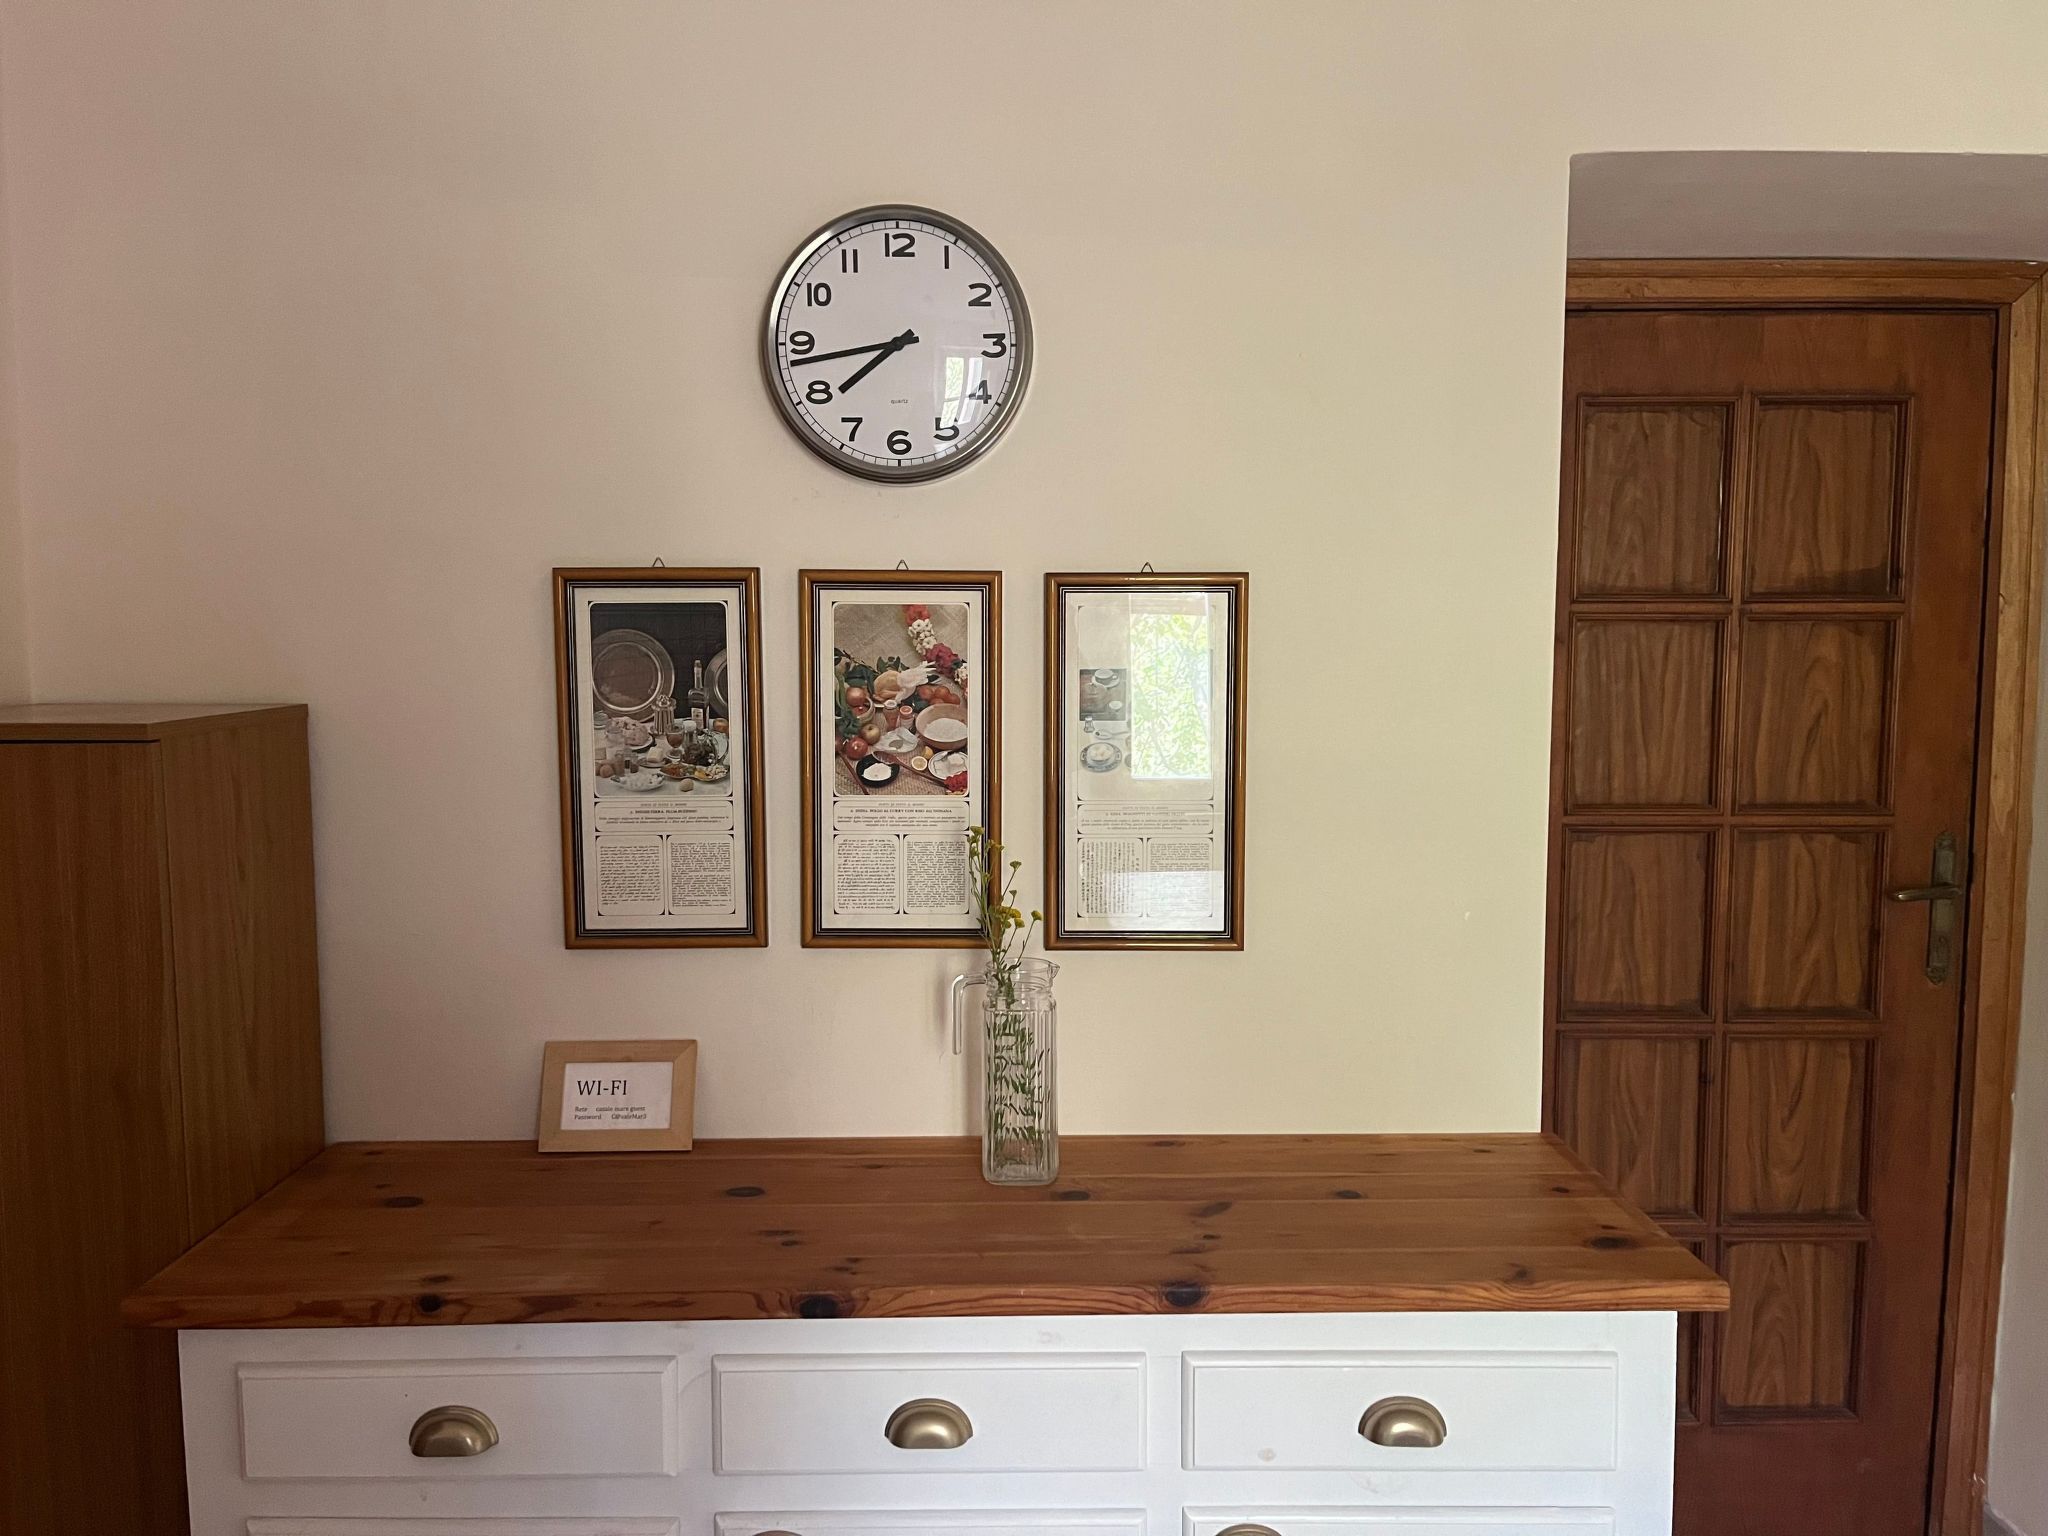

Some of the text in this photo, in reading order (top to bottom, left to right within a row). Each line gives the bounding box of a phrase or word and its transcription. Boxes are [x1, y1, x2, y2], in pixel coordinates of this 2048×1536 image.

[884, 233, 916, 258] 12
[944, 245, 950, 269] 1
[841, 249, 859, 273] 11
[806, 282, 832, 307] 10
[968, 282, 992, 307] 2
[789, 331, 815, 356] 9
[981, 333, 1007, 358] 3
[806, 380, 833, 405] 8
[968, 380, 993, 405] 4
[840, 417, 863, 442] 7
[933, 417, 960, 442] 5
[886, 430, 912, 455] 6
[577, 1080, 628, 1096] WI-FI
